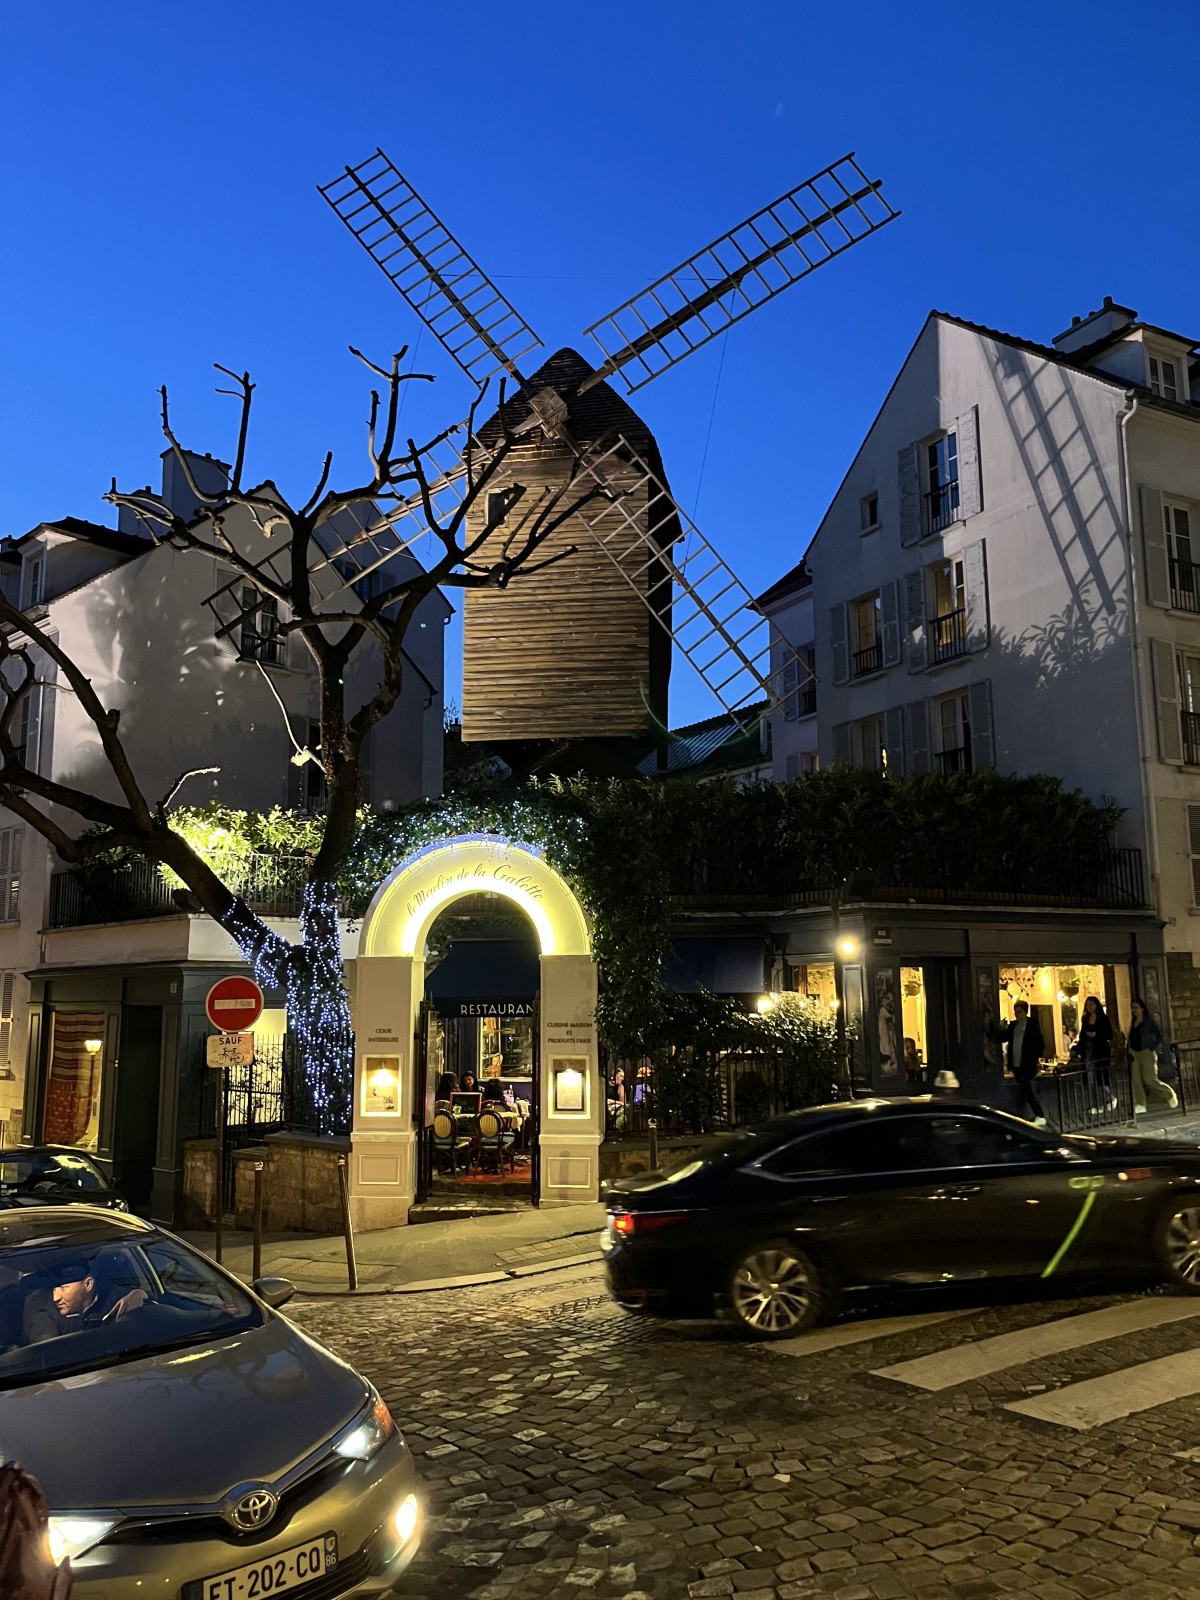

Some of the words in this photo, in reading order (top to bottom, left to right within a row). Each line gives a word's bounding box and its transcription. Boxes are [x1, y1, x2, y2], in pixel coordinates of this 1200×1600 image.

[413, 874, 453, 907] Moulin
[457, 867, 470, 880] de
[473, 863, 487, 878] la
[493, 864, 544, 900] Galette
[218, 1036, 243, 1045] SAUF
[325, 1552, 337, 1567] 86
